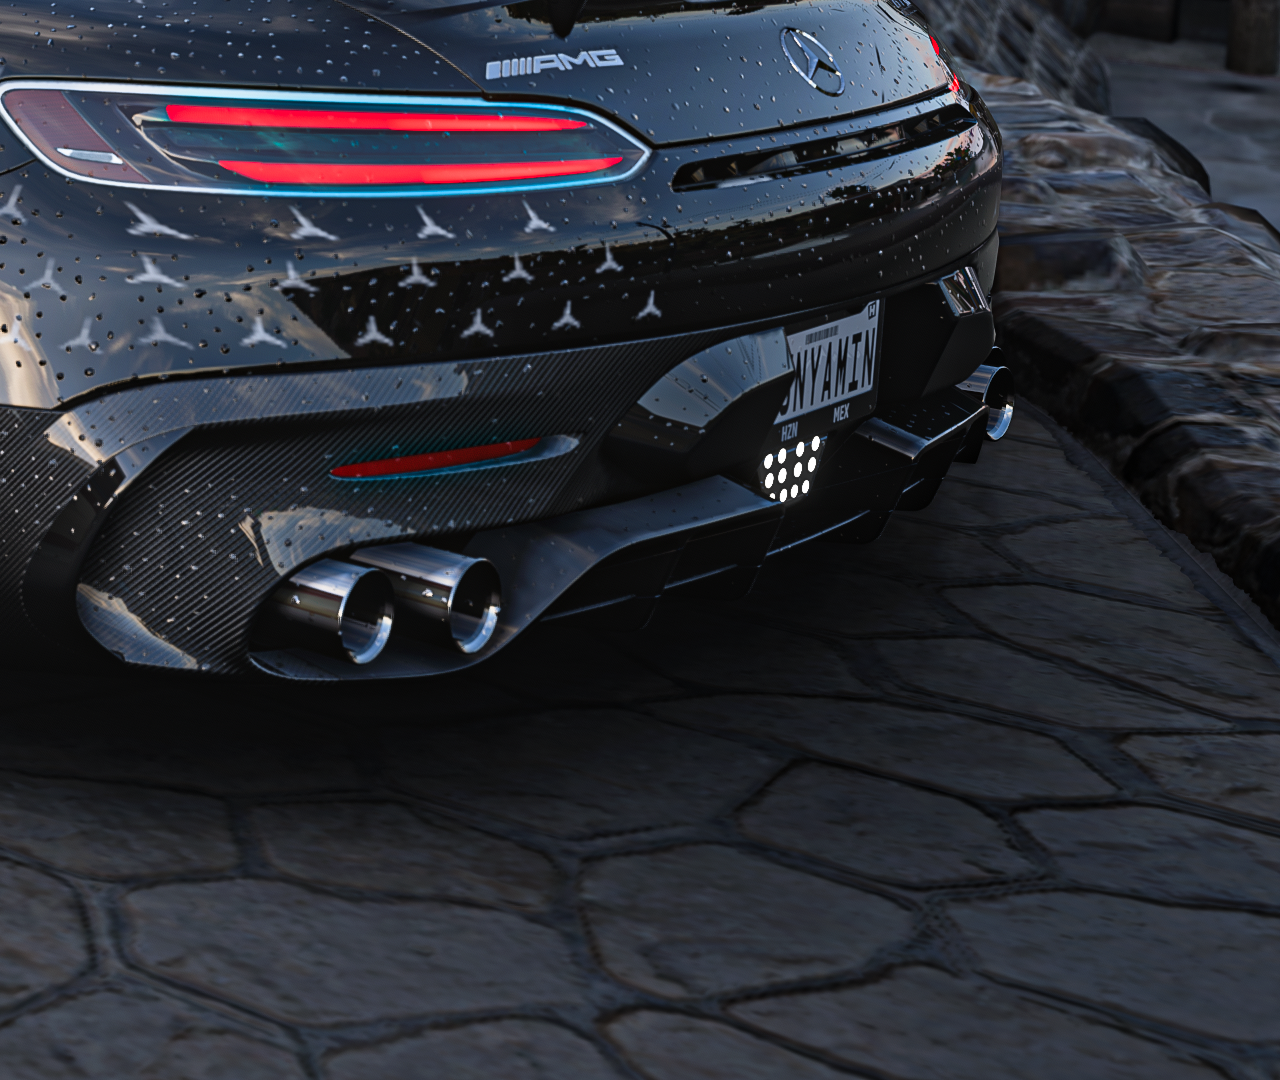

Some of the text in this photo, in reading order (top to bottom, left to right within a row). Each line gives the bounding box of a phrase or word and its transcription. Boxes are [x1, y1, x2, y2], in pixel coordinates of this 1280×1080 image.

[533, 49, 624, 74] AMG
[833, 402, 850, 423] MEX
[781, 421, 798, 442] HZN
